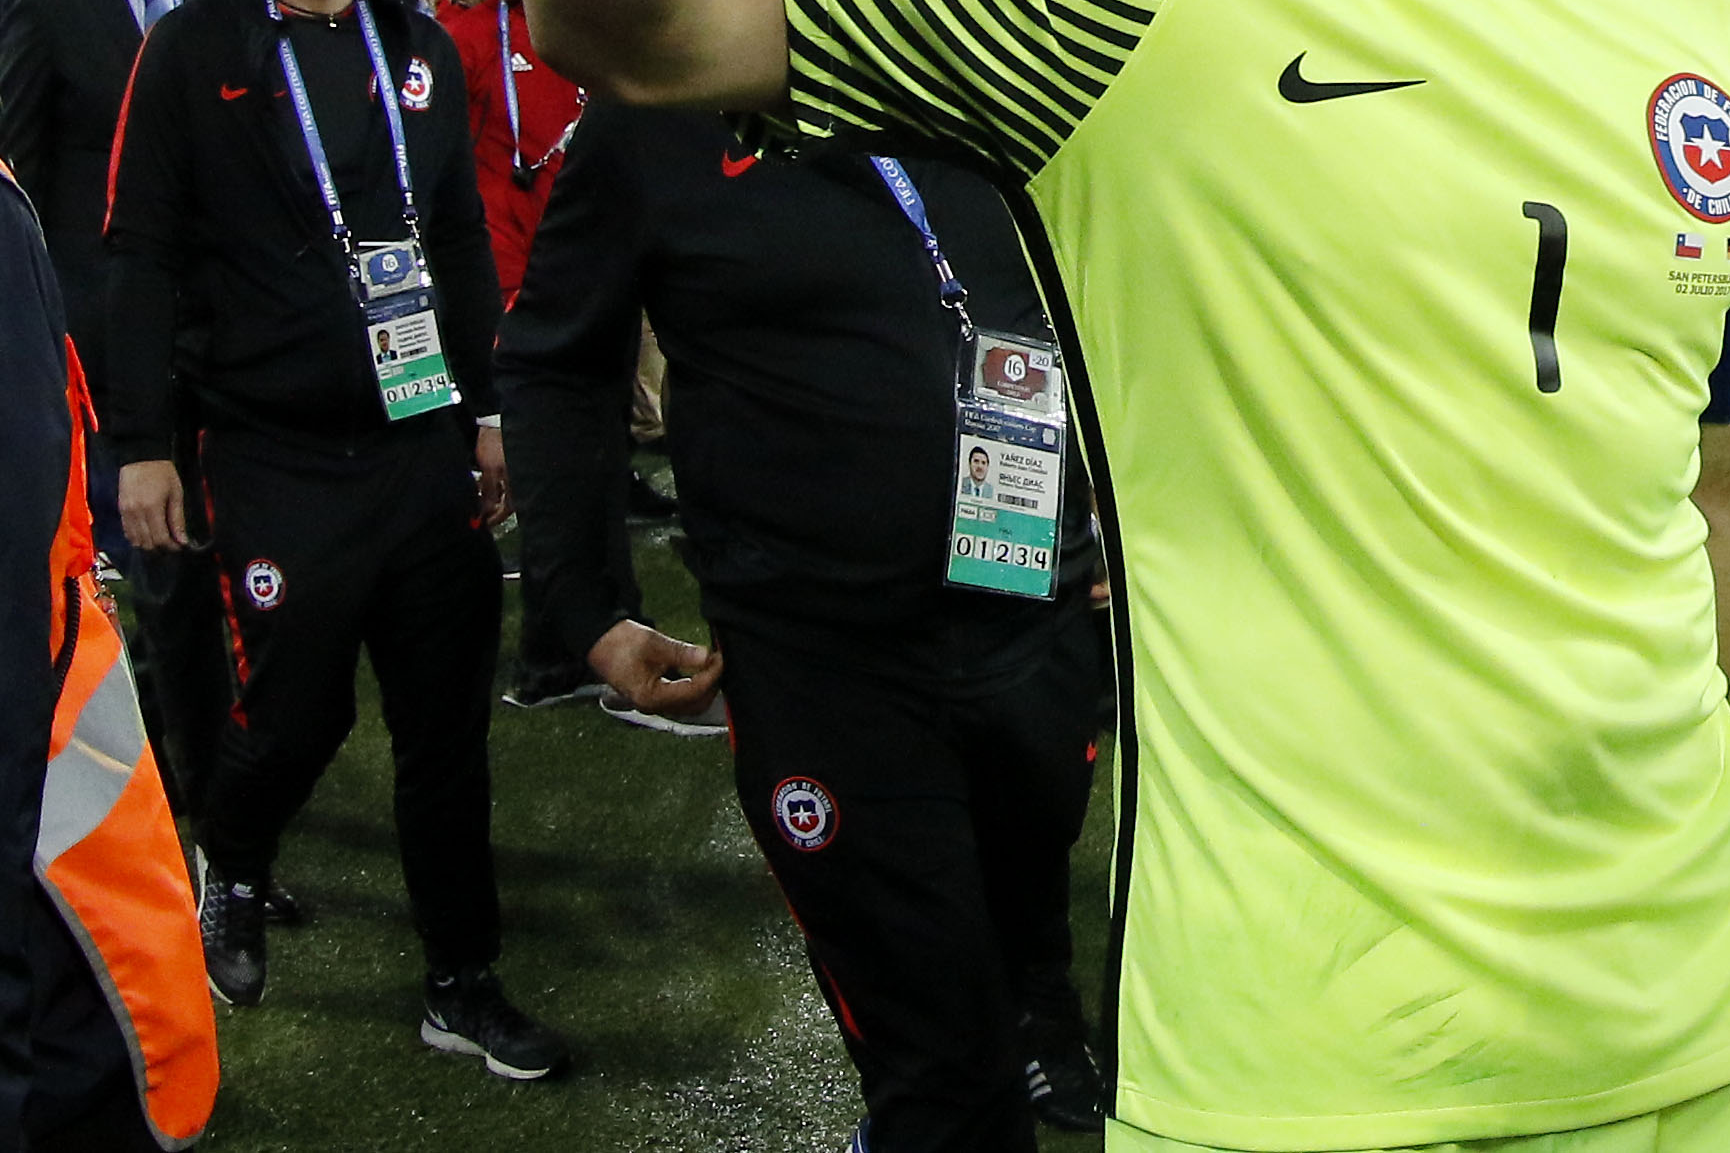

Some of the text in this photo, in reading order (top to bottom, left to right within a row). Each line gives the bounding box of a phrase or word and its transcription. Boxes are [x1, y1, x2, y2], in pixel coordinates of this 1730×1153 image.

[1654, 79, 1698, 142] FEDERACION
[1703, 83, 1719, 103] DE
[1668, 270, 1689, 283] SAN
[1522, 200, 1568, 393] 1
[1675, 283, 1688, 294] 02
[1689, 284, 1714, 295] JULIO
[1008, 359, 1023, 376] 16
